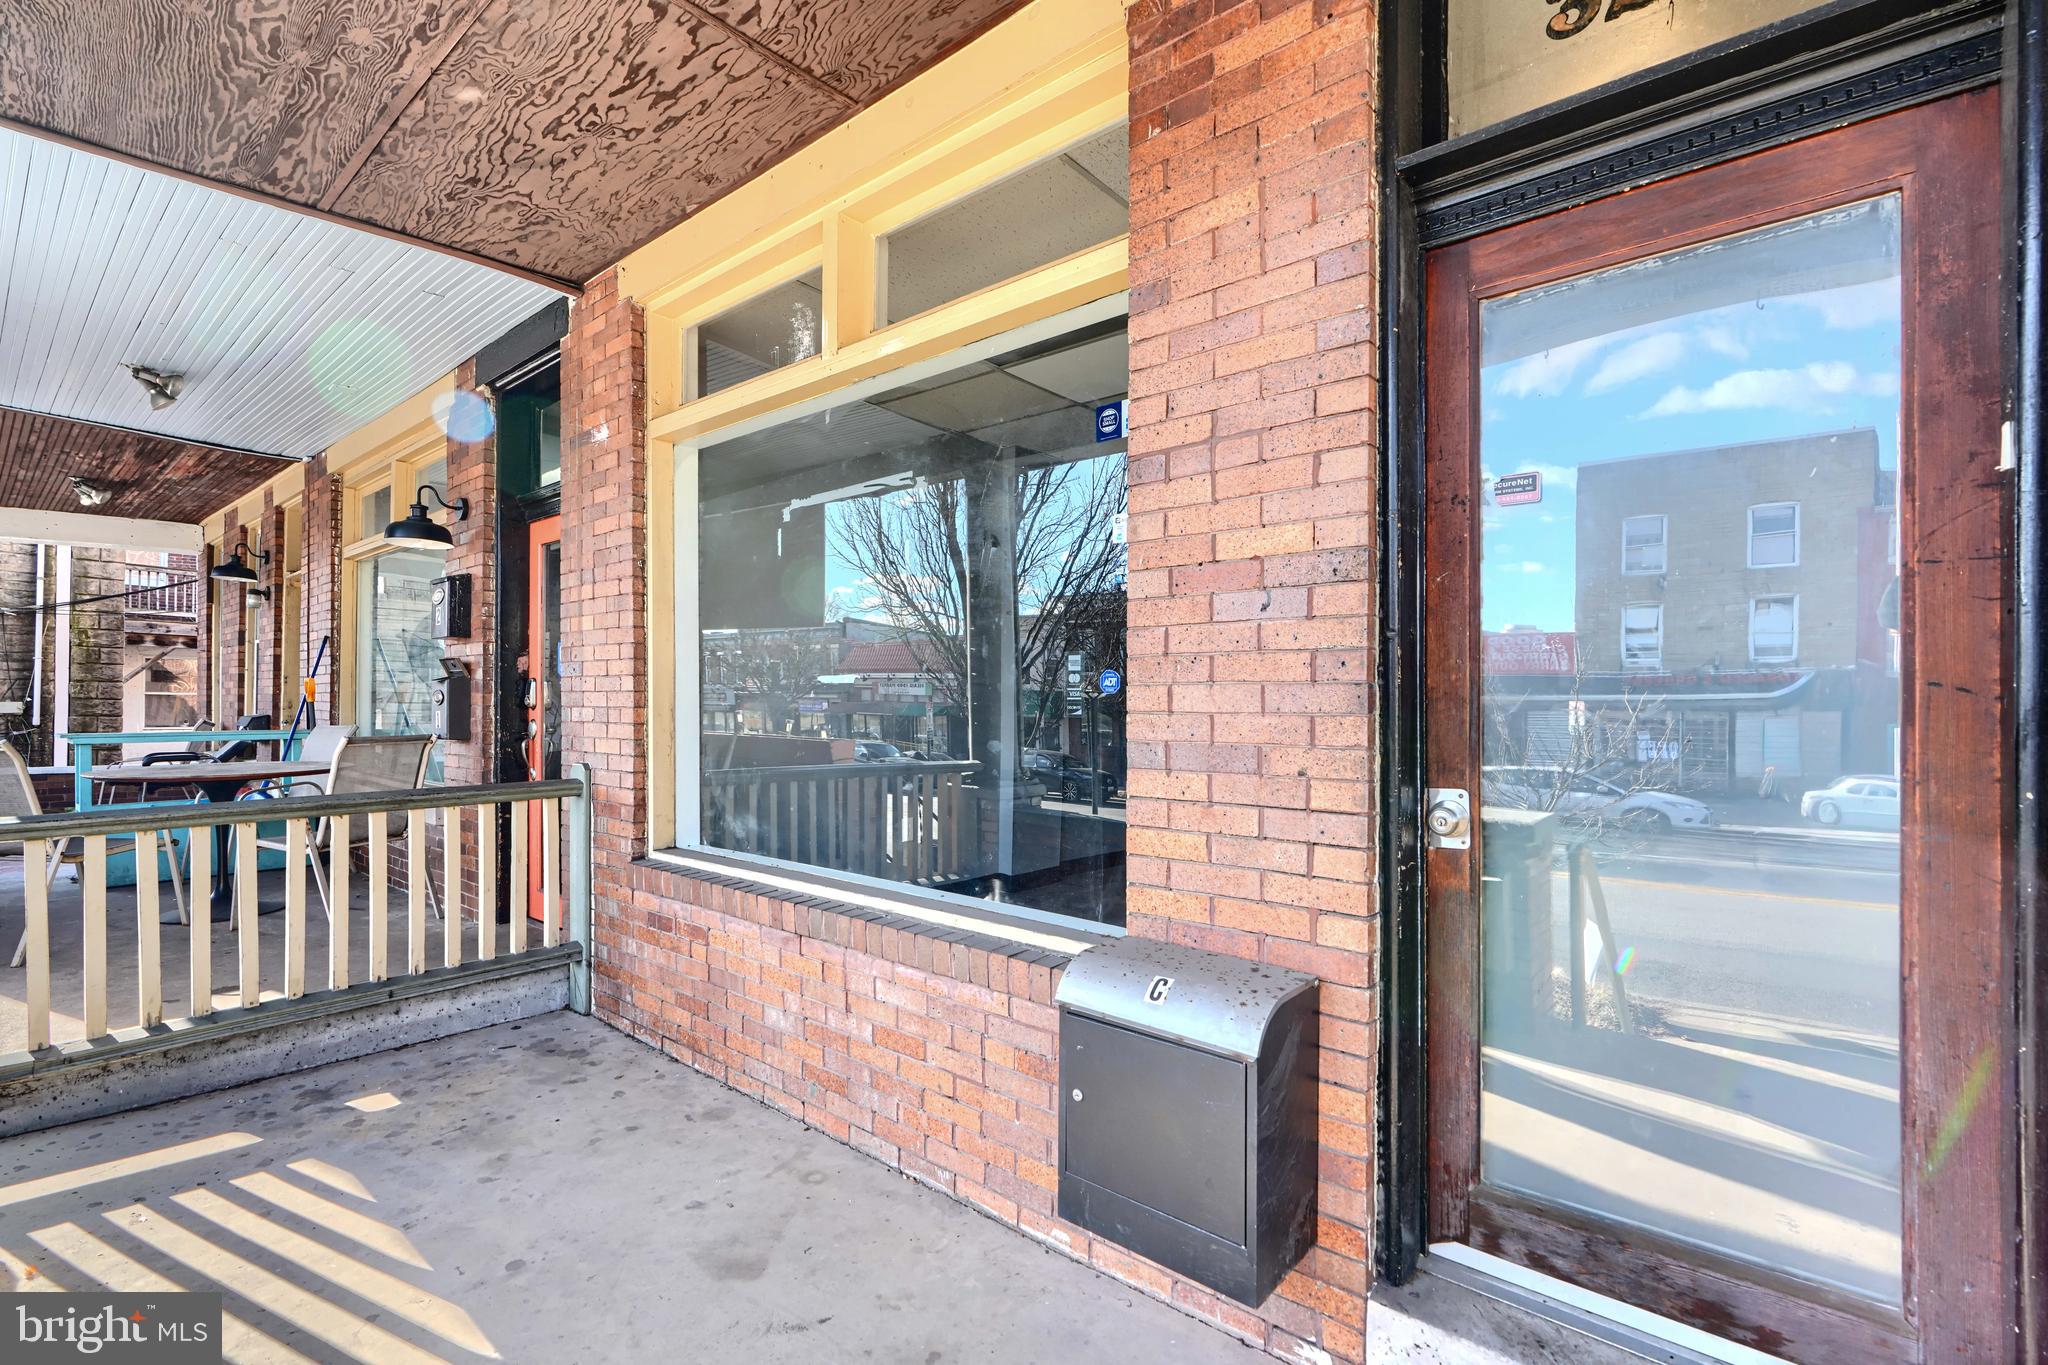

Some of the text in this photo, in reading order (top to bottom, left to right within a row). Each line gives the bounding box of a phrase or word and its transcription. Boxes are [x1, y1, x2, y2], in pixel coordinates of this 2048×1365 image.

[1492, 478, 1533, 489] ecureNet
[1103, 677, 1118, 687] ADT
[1149, 977, 1169, 1002] C
